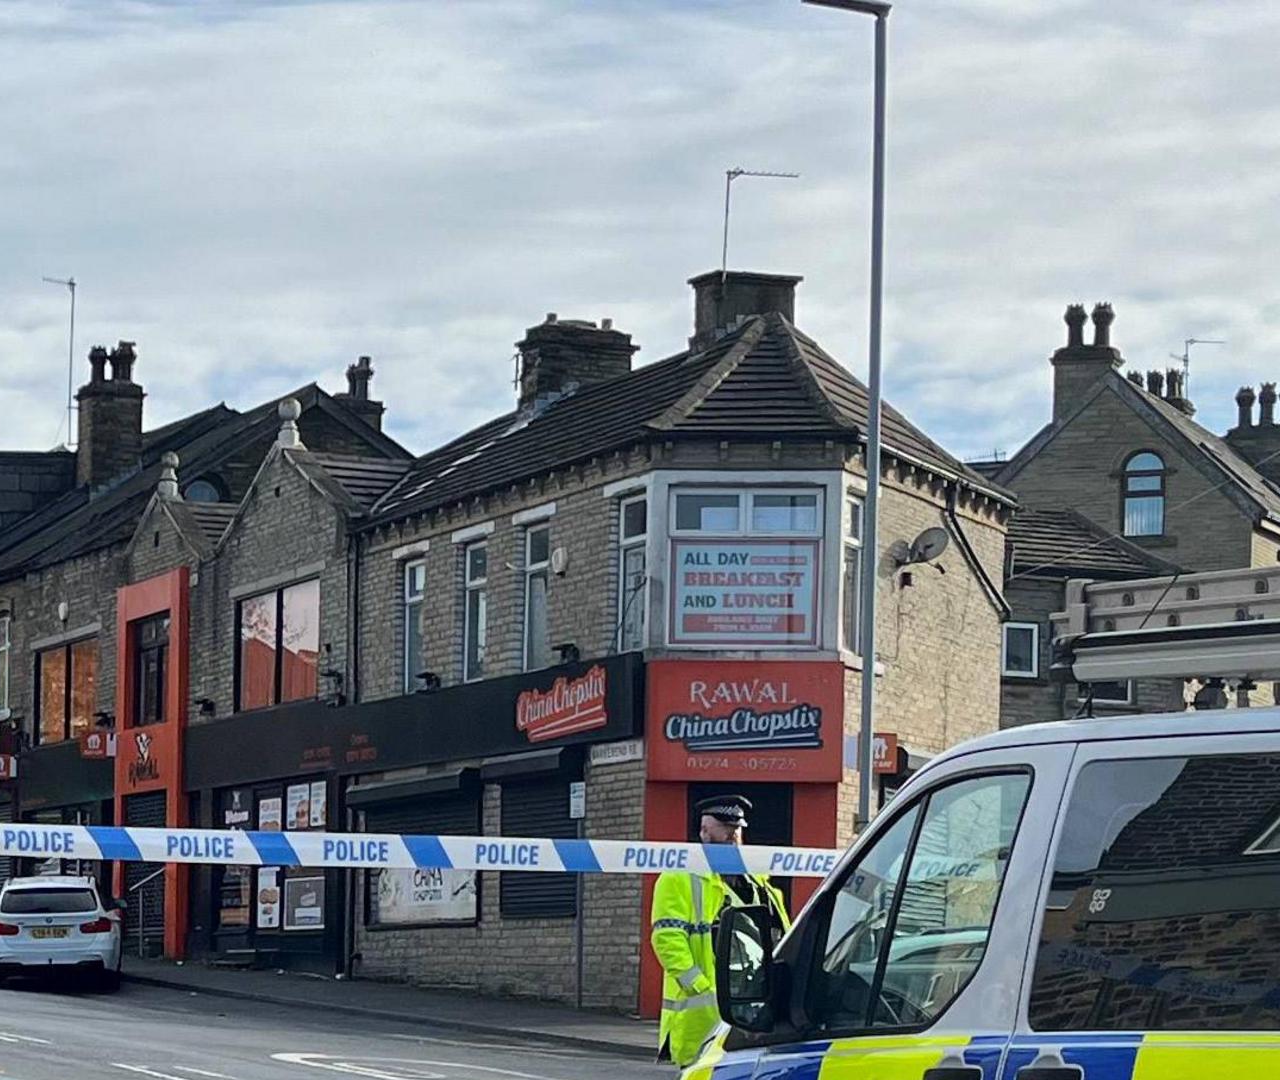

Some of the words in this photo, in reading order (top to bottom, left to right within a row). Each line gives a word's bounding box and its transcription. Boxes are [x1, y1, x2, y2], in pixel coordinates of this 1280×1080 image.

[684, 552, 711, 566] ALL
[718, 552, 749, 566] DAY
[683, 595, 717, 608] AND
[722, 593, 794, 608] LUNCH
[691, 679, 797, 709] RAWAL
[4, 829, 74, 853] POLICE
[167, 835, 234, 857] POLICE
[324, 840, 388, 861] POLICE
[475, 843, 539, 865] POLICE
[623, 848, 687, 868] POLICE
[770, 851, 835, 872] POLICE
